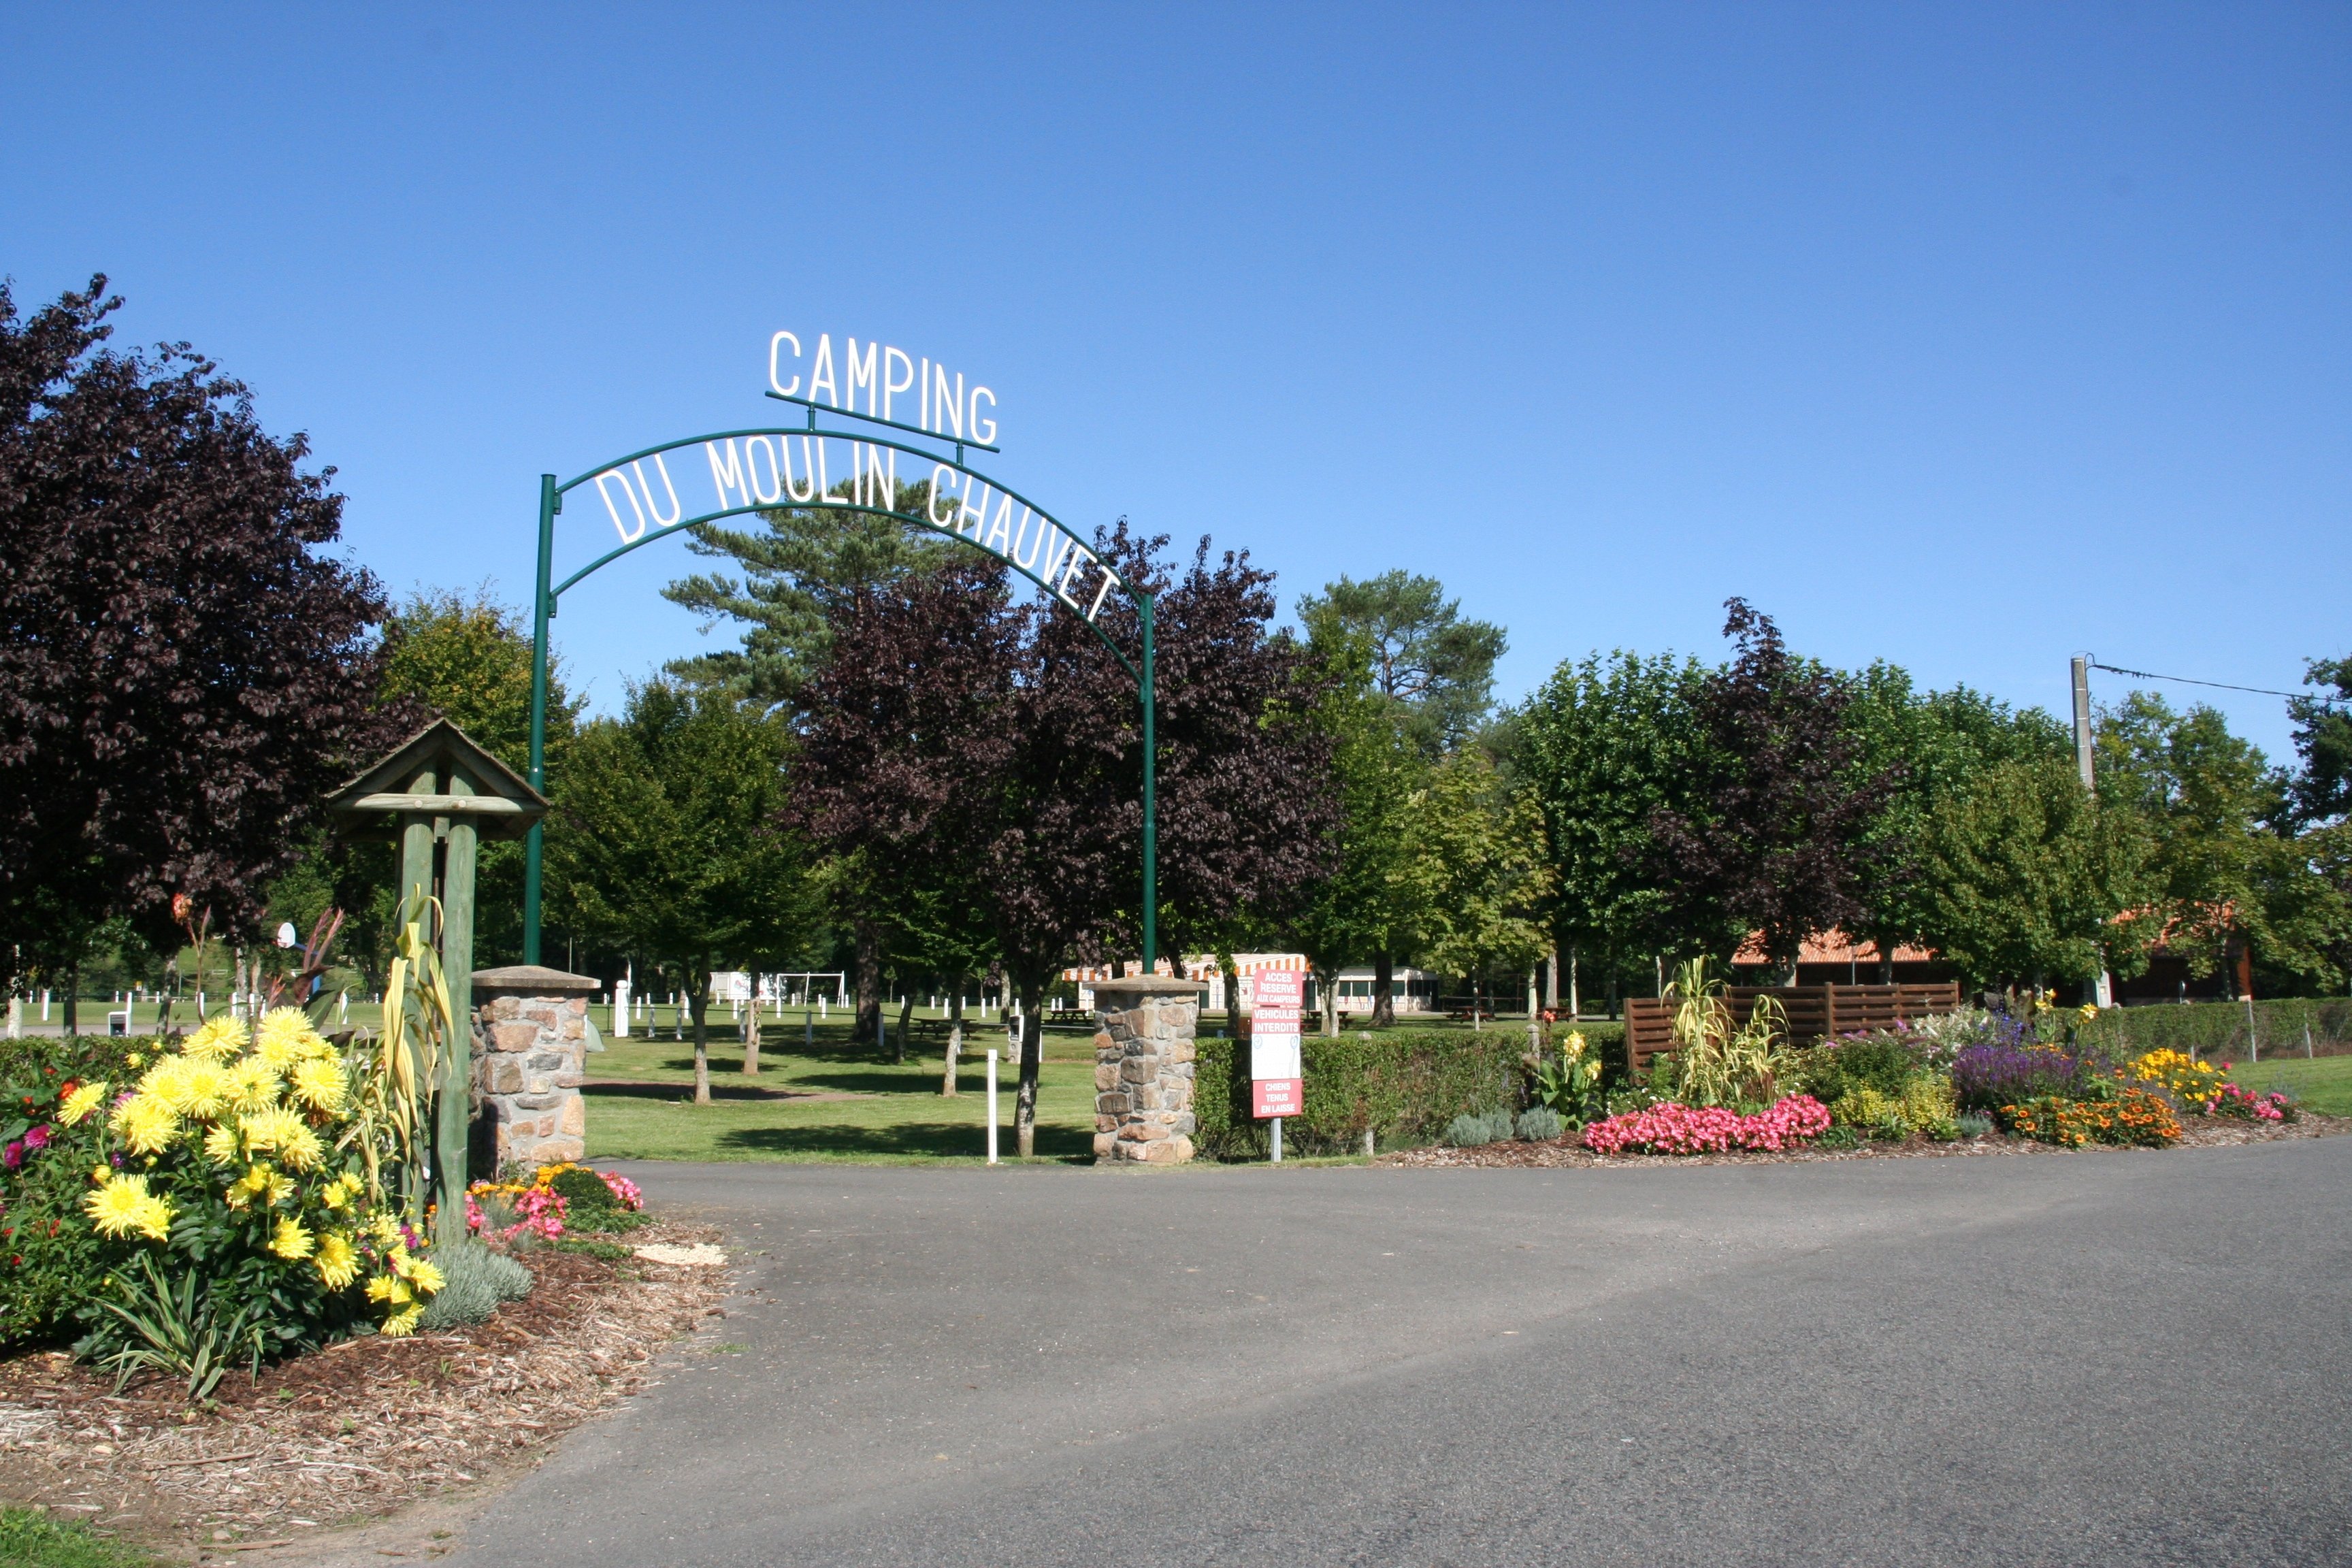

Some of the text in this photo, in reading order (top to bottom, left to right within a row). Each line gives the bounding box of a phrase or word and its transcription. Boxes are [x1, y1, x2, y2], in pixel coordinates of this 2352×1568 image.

[770, 331, 998, 446] CAMPING
[595, 434, 1122, 622] DU MOULIN CHAUVET
[1264, 973, 1292, 983] ACCES
[1260, 983, 1296, 994] RESERVE
[1256, 994, 1301, 1004] AUX CAMPEURS
[1254, 1009, 1298, 1019] VEHICULES
[1254, 1022, 1298, 1032] INTERDITS
[1265, 1083, 1291, 1092] CHIENS
[1266, 1094, 1288, 1102] TENUS
[1261, 1104, 1295, 1114] EN LAISSE
